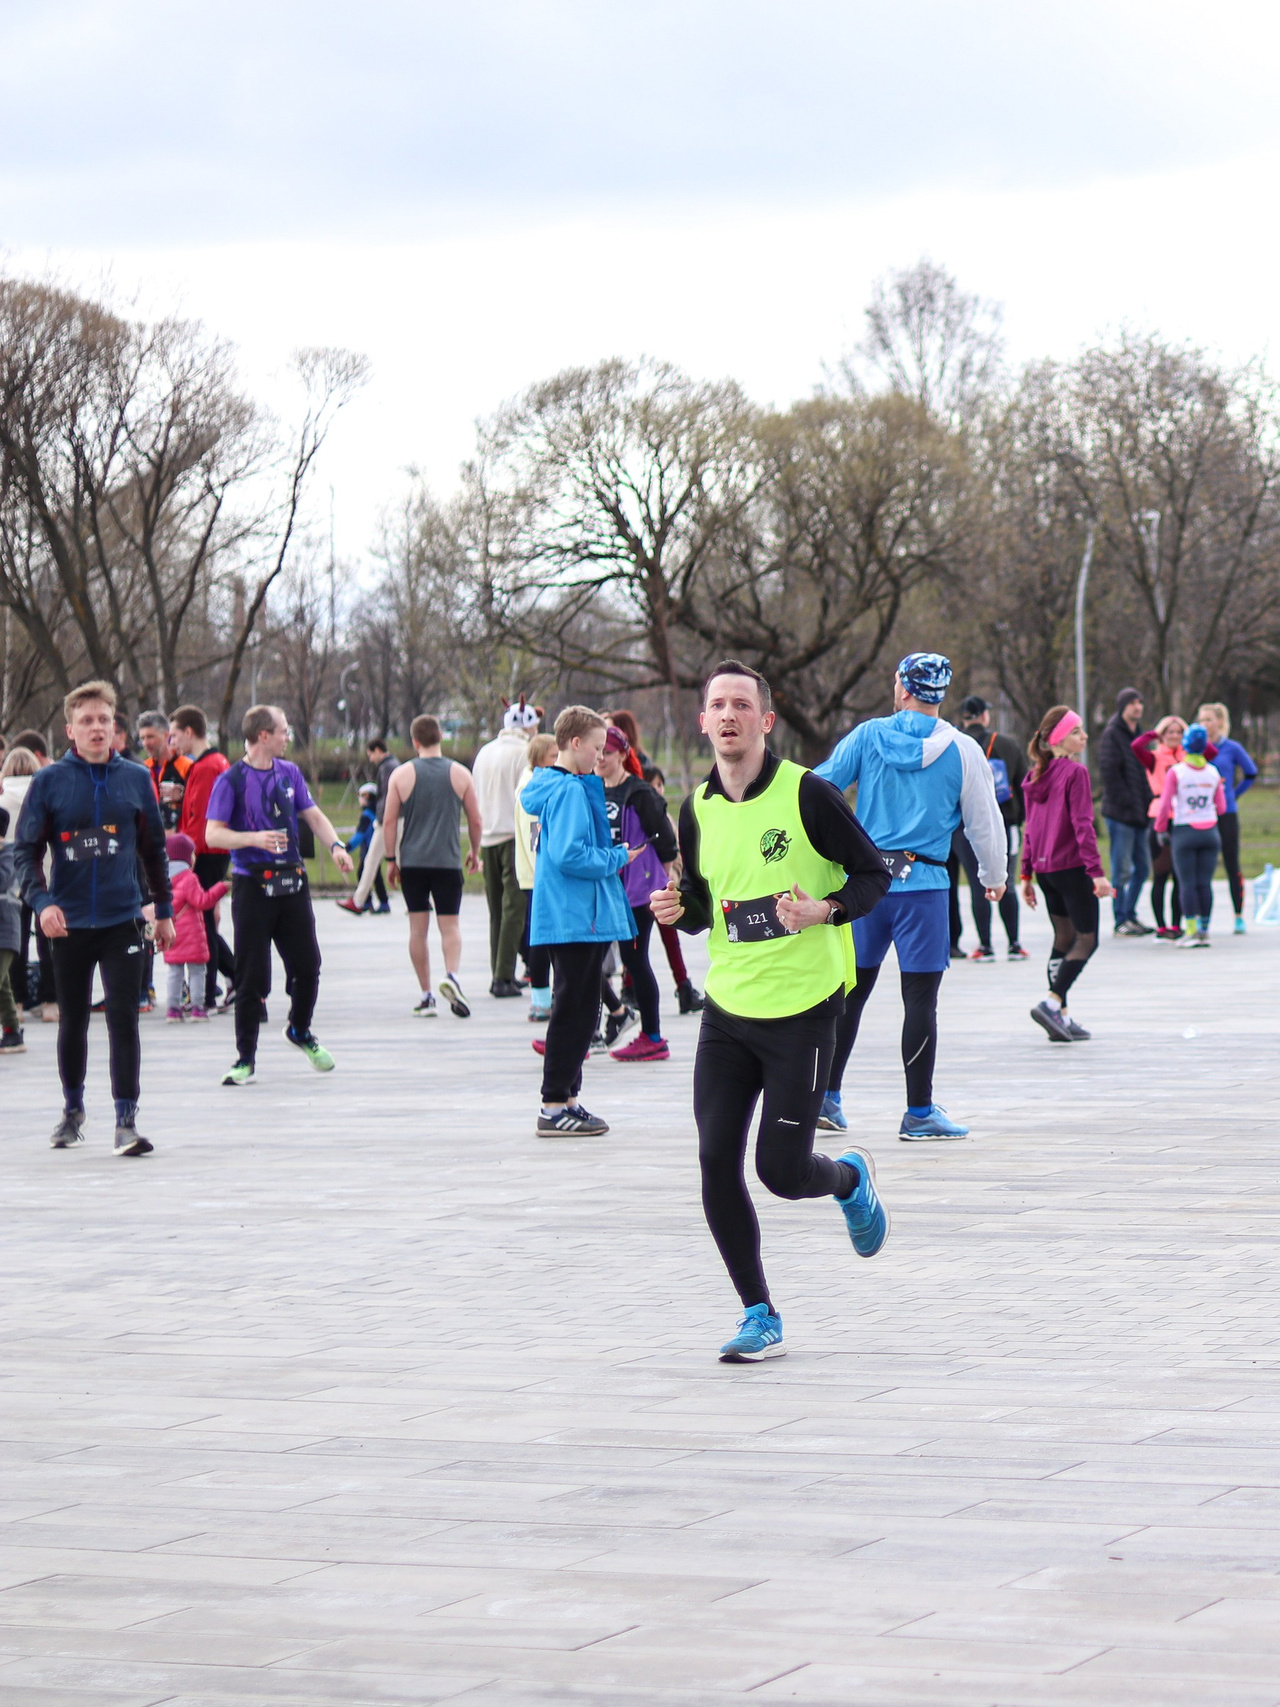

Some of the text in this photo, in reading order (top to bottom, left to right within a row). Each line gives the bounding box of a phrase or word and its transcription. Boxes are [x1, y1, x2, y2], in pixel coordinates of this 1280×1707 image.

[83, 837, 98, 848] 123
[882, 857, 895, 866] 17
[746, 912, 768, 925] 121
